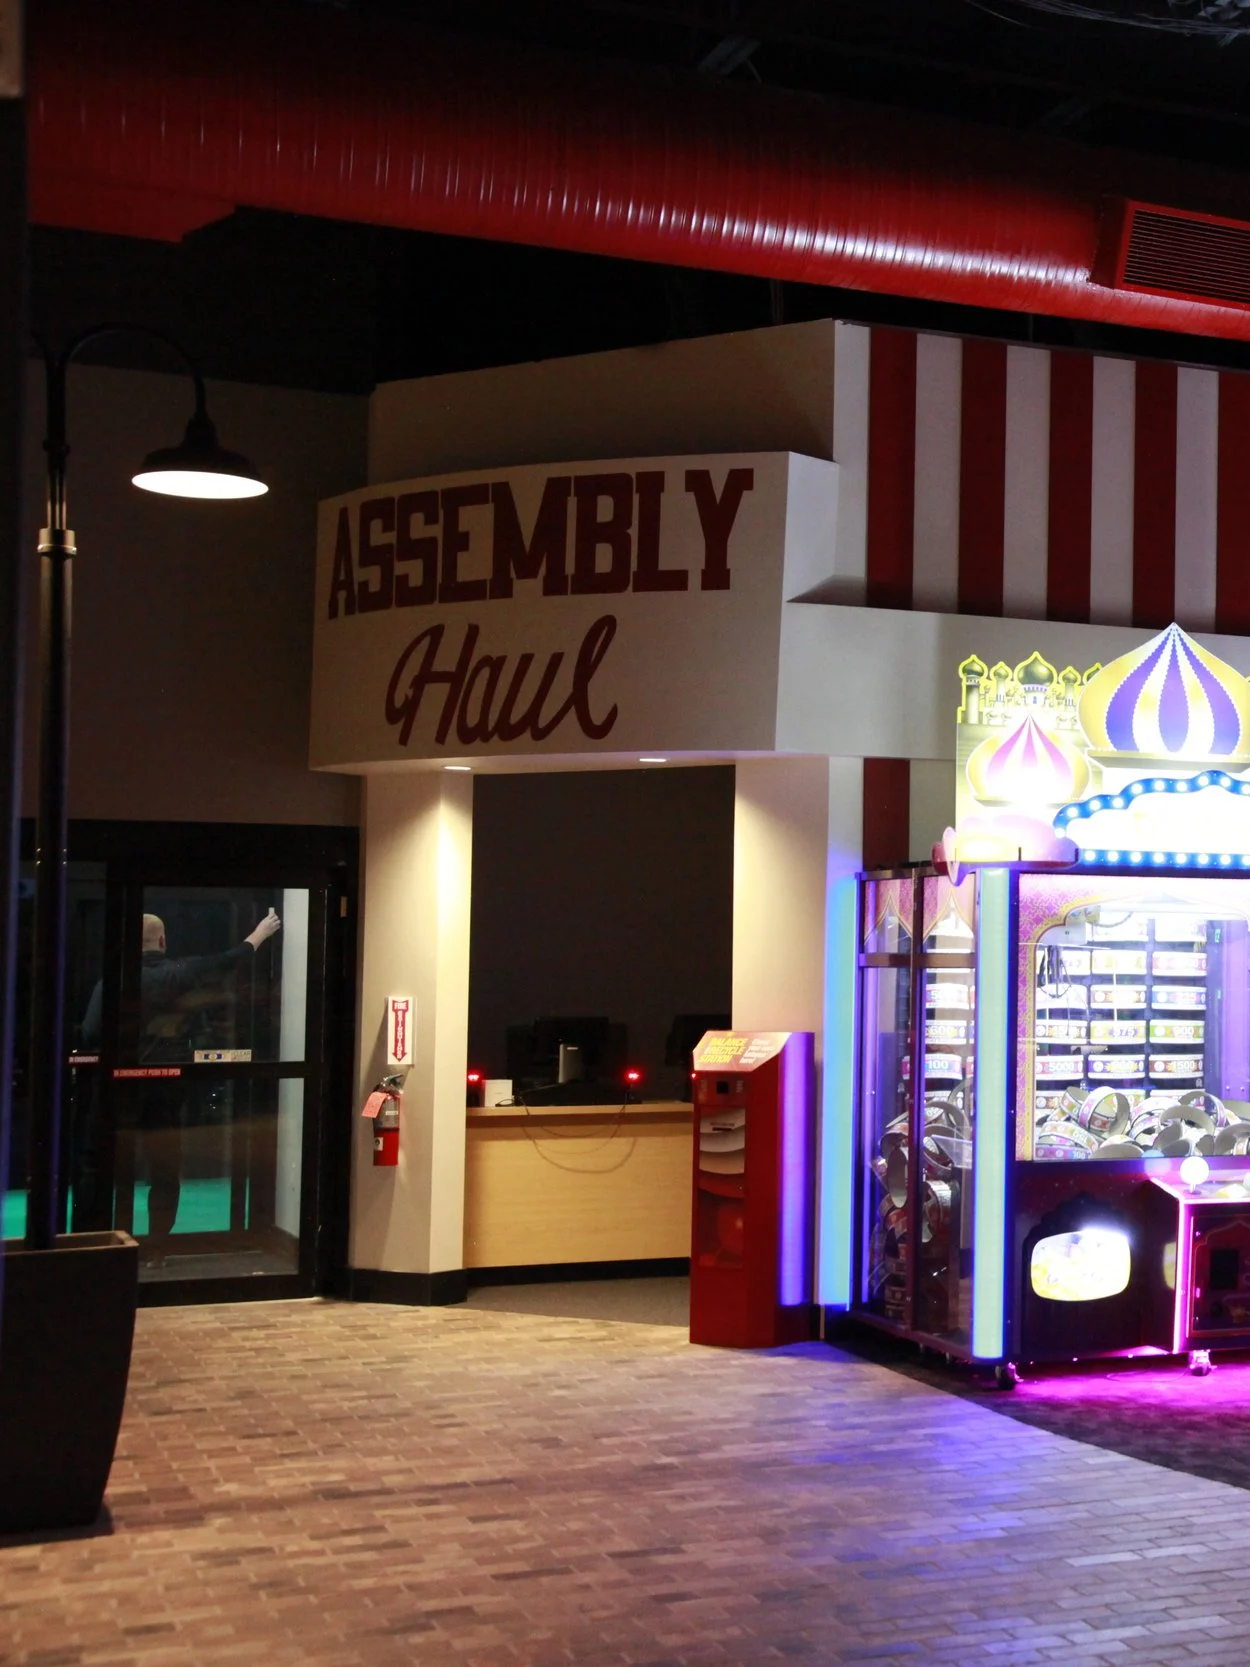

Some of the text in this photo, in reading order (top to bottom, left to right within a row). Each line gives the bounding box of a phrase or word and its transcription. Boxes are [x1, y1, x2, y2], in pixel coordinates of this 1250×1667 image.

[328, 468, 754, 620] ASSEMBLY
[384, 614, 618, 747] Haul
[119, 1069, 148, 1077] EMERGENCY
